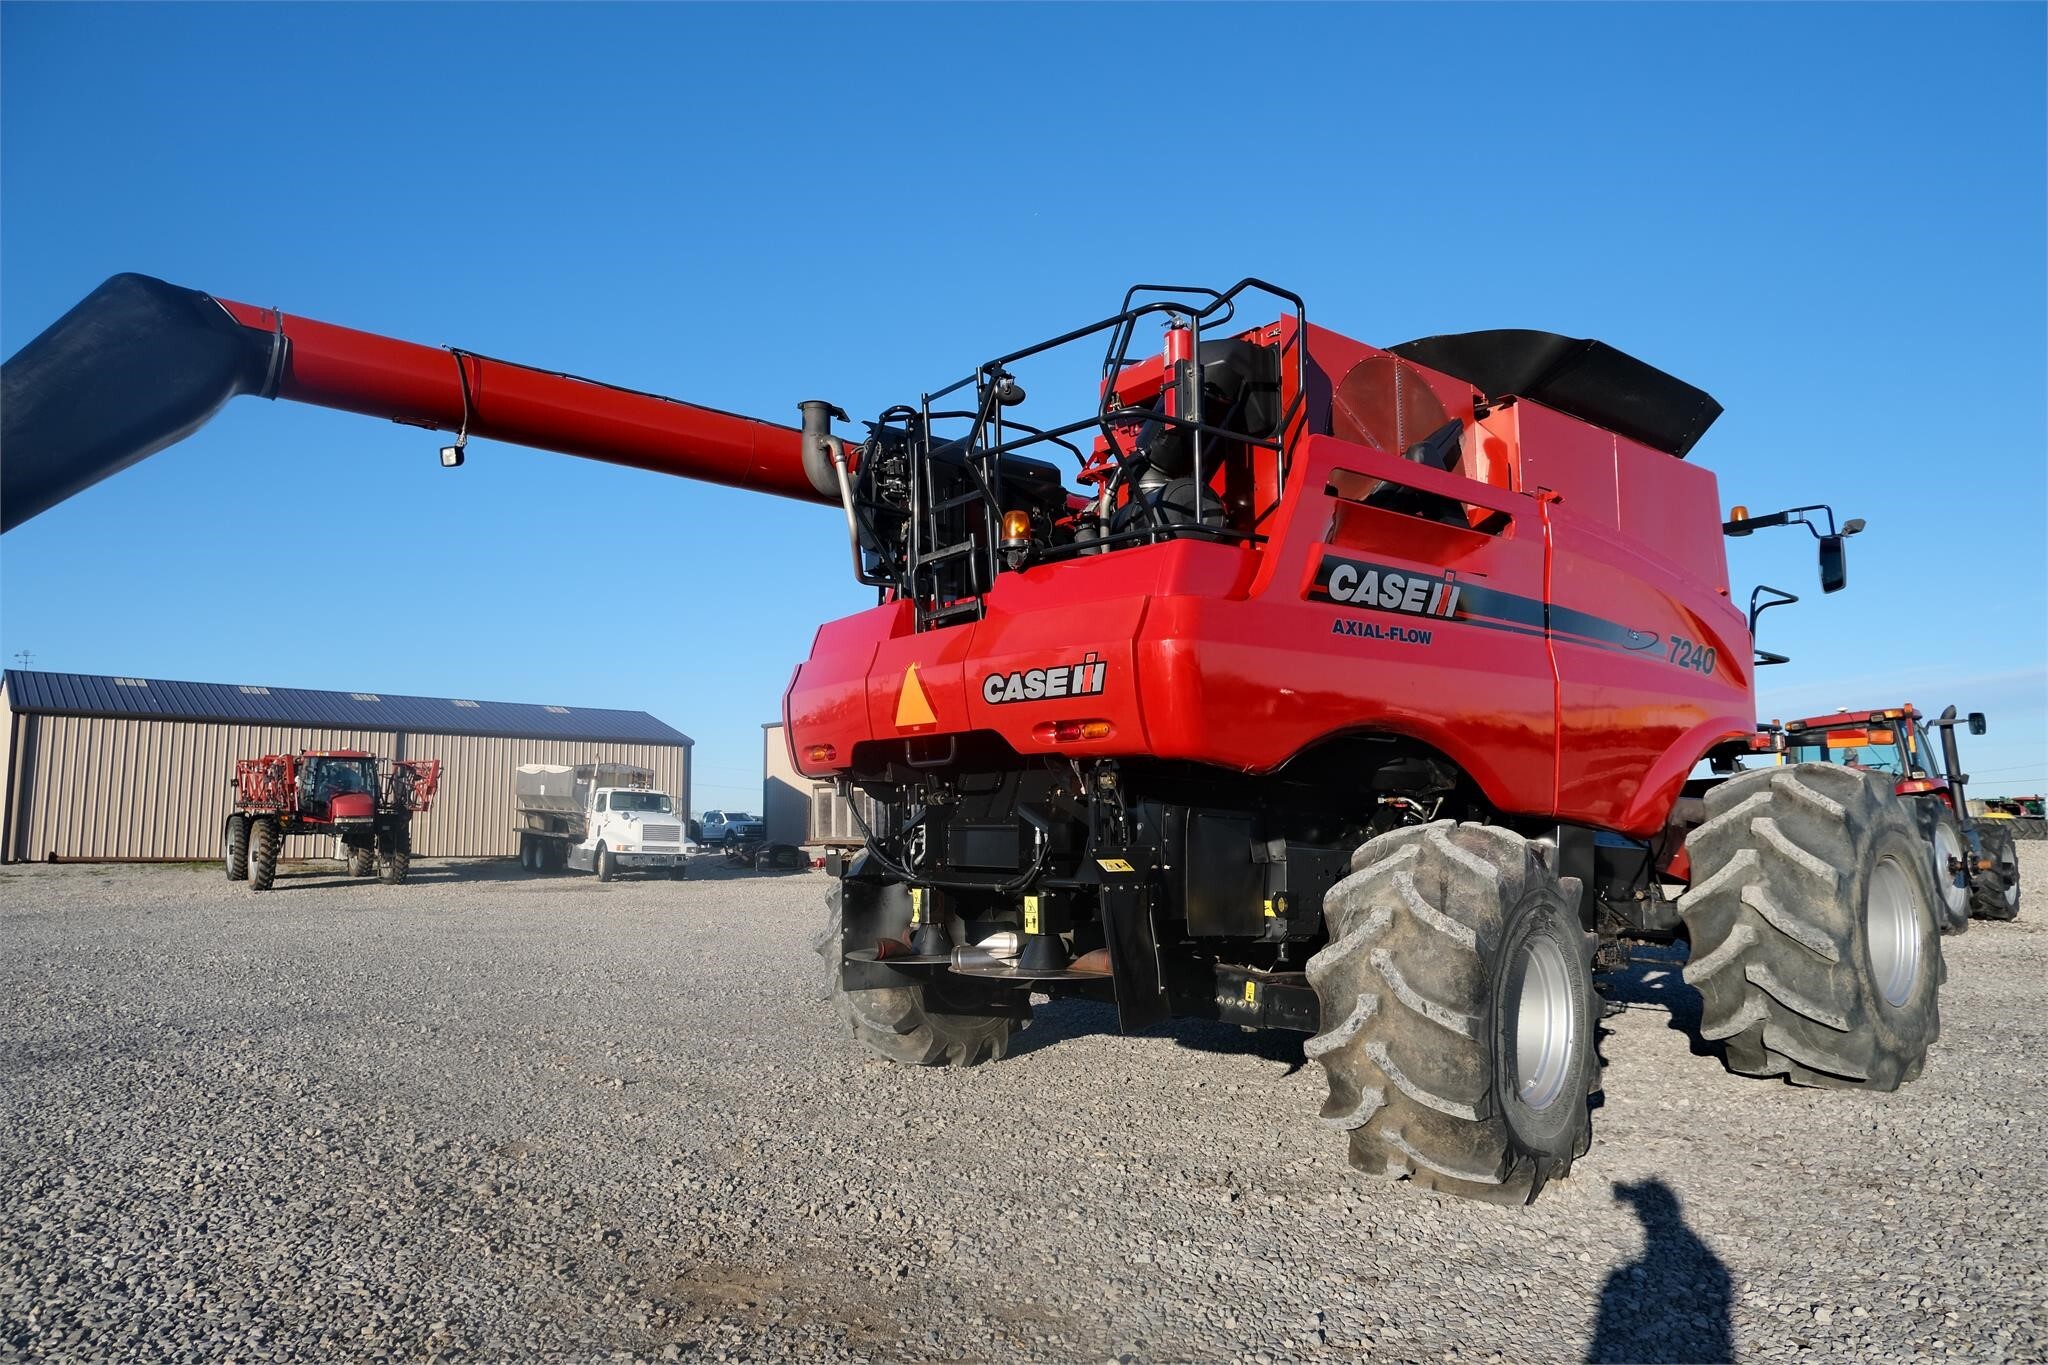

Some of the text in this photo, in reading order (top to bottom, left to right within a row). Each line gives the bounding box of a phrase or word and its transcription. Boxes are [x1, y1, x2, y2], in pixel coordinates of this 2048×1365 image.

[1328, 564, 1430, 612] CASE
[1332, 619, 1432, 645] AXIAL-FLOW
[1669, 634, 1716, 675] 7240
[983, 667, 1069, 703] CASE
